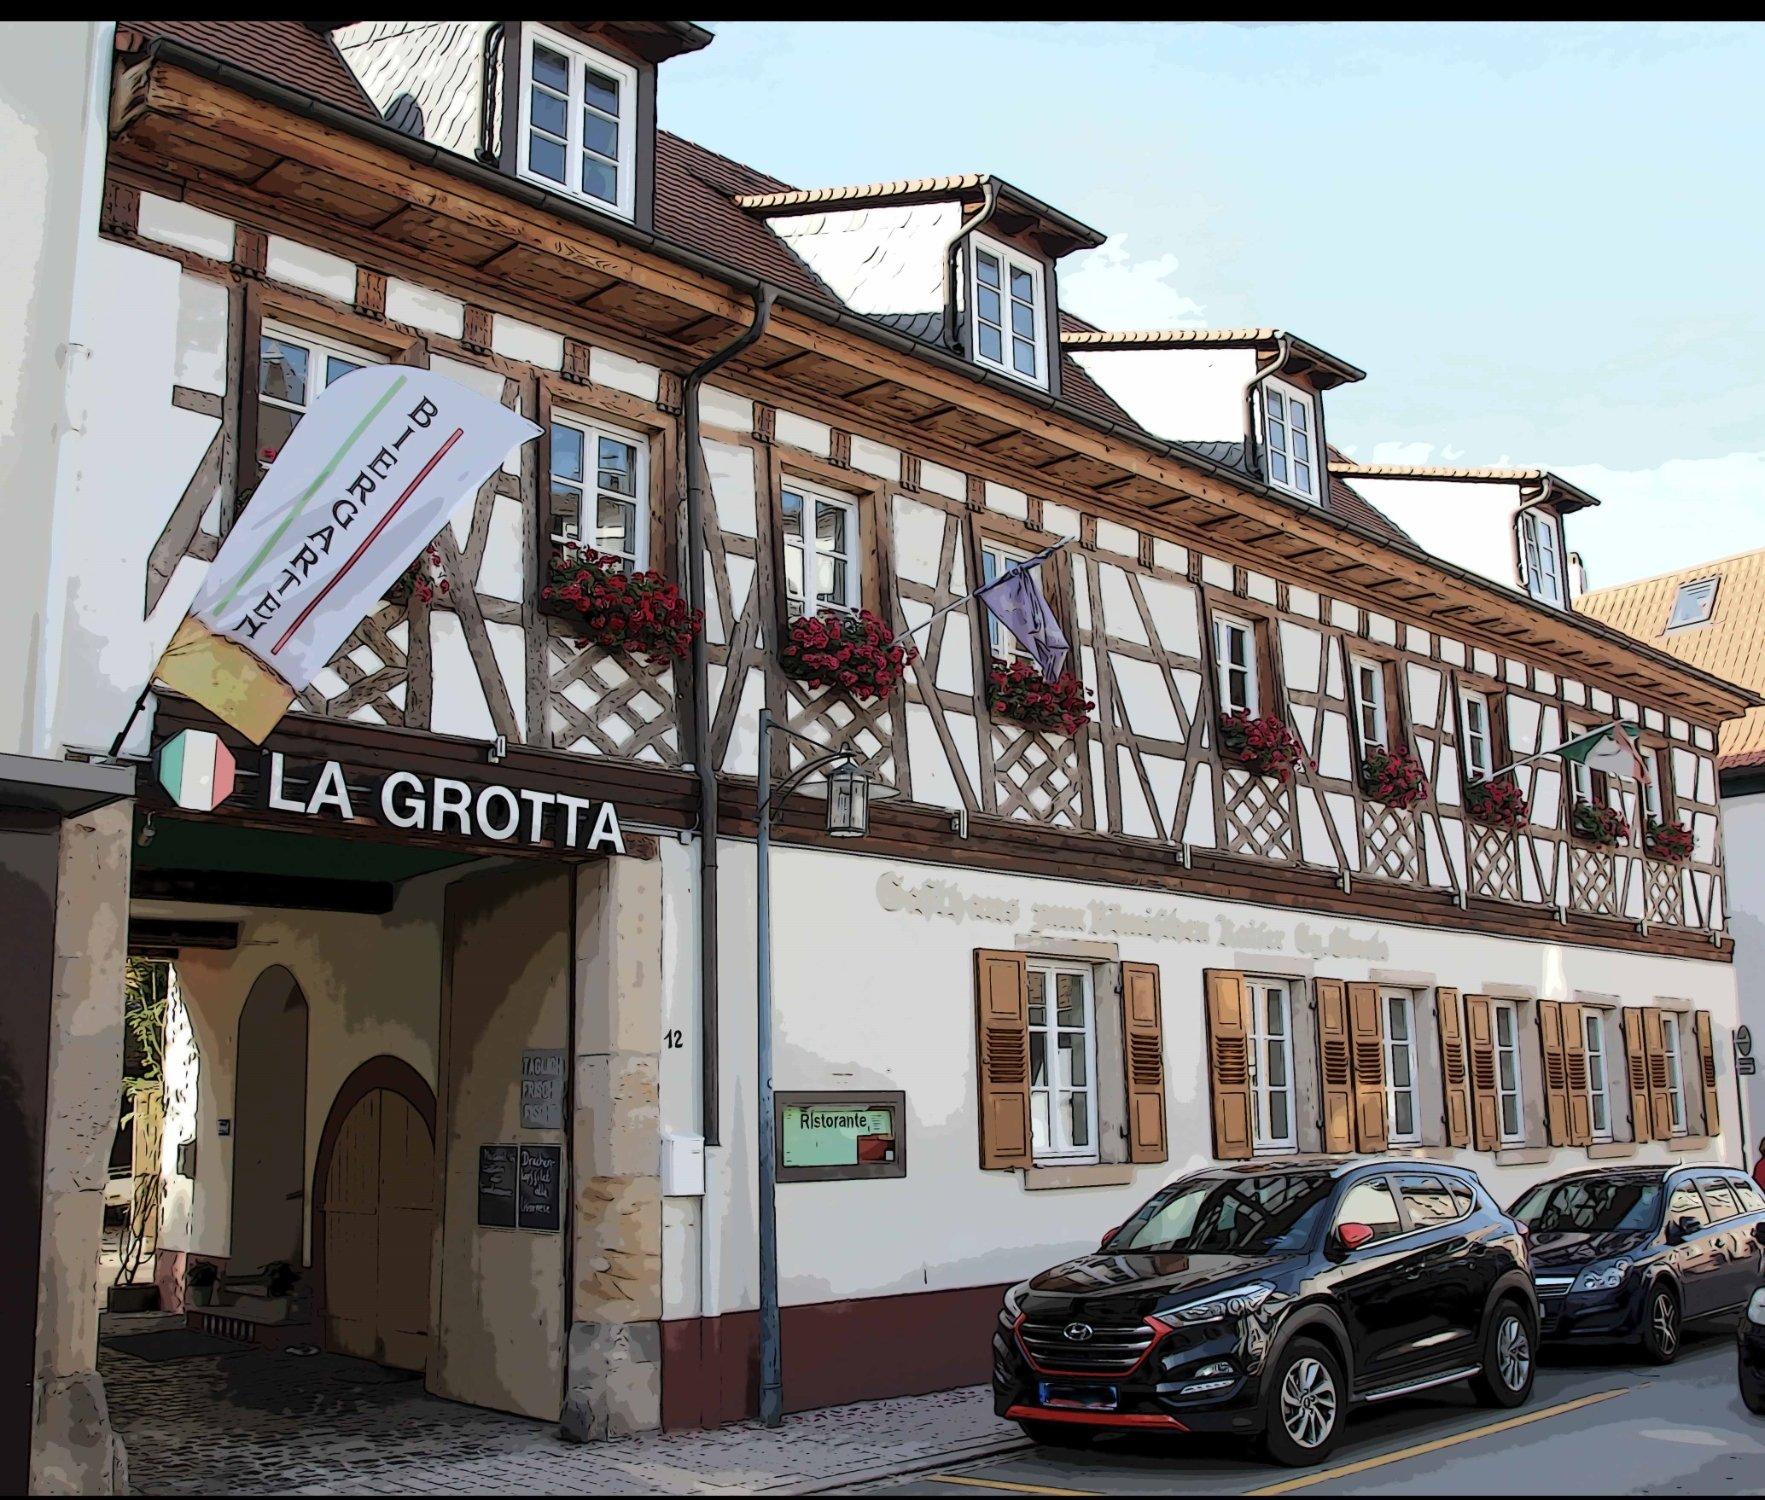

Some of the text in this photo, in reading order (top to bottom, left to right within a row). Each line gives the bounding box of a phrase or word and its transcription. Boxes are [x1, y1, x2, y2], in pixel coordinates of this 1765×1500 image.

[232, 396, 439, 640] BIERGARTEN
[266, 752, 627, 854] LA GROTTA
[664, 1029, 684, 1049] 12
[800, 1112, 867, 1129] Ristorante
